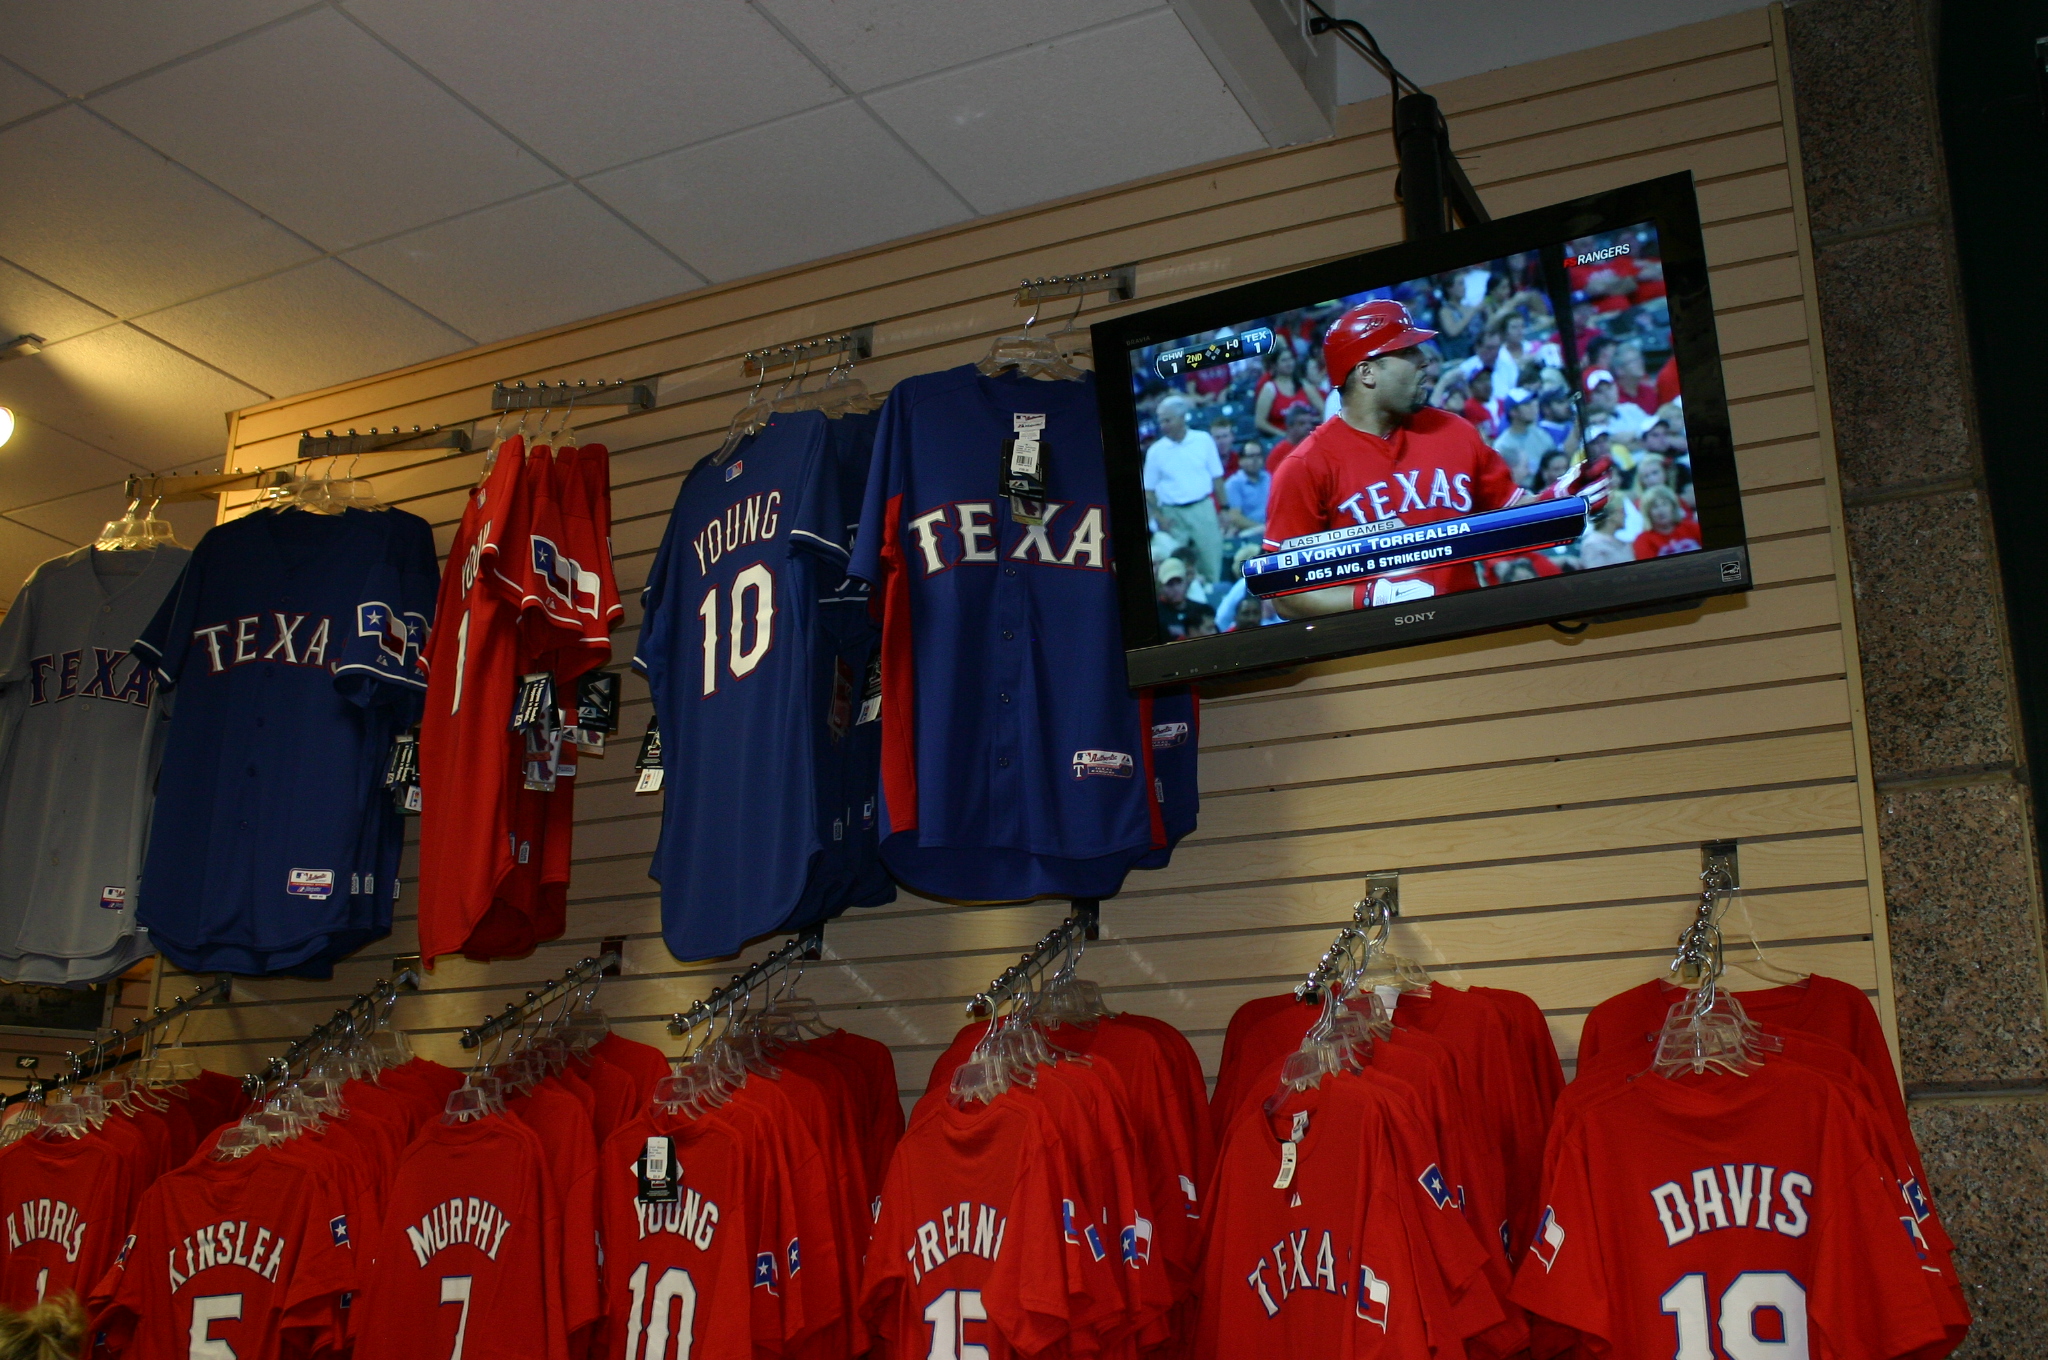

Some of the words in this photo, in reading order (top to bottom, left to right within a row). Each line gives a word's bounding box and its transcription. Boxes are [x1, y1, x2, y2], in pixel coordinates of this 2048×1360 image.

[1577, 243, 1630, 266] RANGERS
[1161, 350, 1183, 362] CHW
[1186, 352, 1203, 364] 2ND
[1244, 330, 1267, 343] TEX
[1170, 362, 1178, 374] 1
[1254, 342, 1261, 354] 1
[1337, 467, 1473, 524] TEXAS
[692, 489, 782, 577] YOUNG
[907, 500, 1117, 579] TEXA
[1284, 555, 1293, 566] 8
[1302, 541, 1362, 563] YORVIT
[1367, 521, 1471, 551] TORREALBA
[1288, 534, 1323, 548] LAST
[1327, 530, 1342, 541] 10
[1346, 520, 1395, 537] GAMES
[1305, 567, 1333, 582] .065
[1336, 561, 1364, 576] AVG,
[1367, 558, 1376, 570] 8
[1379, 545, 1453, 568] STRIKEOUTS
[191, 610, 344, 676] TEXA
[698, 560, 778, 700] 10
[1393, 610, 1437, 626] SONY
[30, 646, 154, 708] TEXA
[405, 1196, 512, 1269] MURPHY
[633, 1184, 719, 1251] YOUNG
[1650, 1164, 1813, 1248] DAVIS
[1247, 1228, 1347, 1319] TEXA
[188, 1292, 243, 1360] 5
[439, 1275, 472, 1360] 7
[625, 1262, 697, 1360] 10
